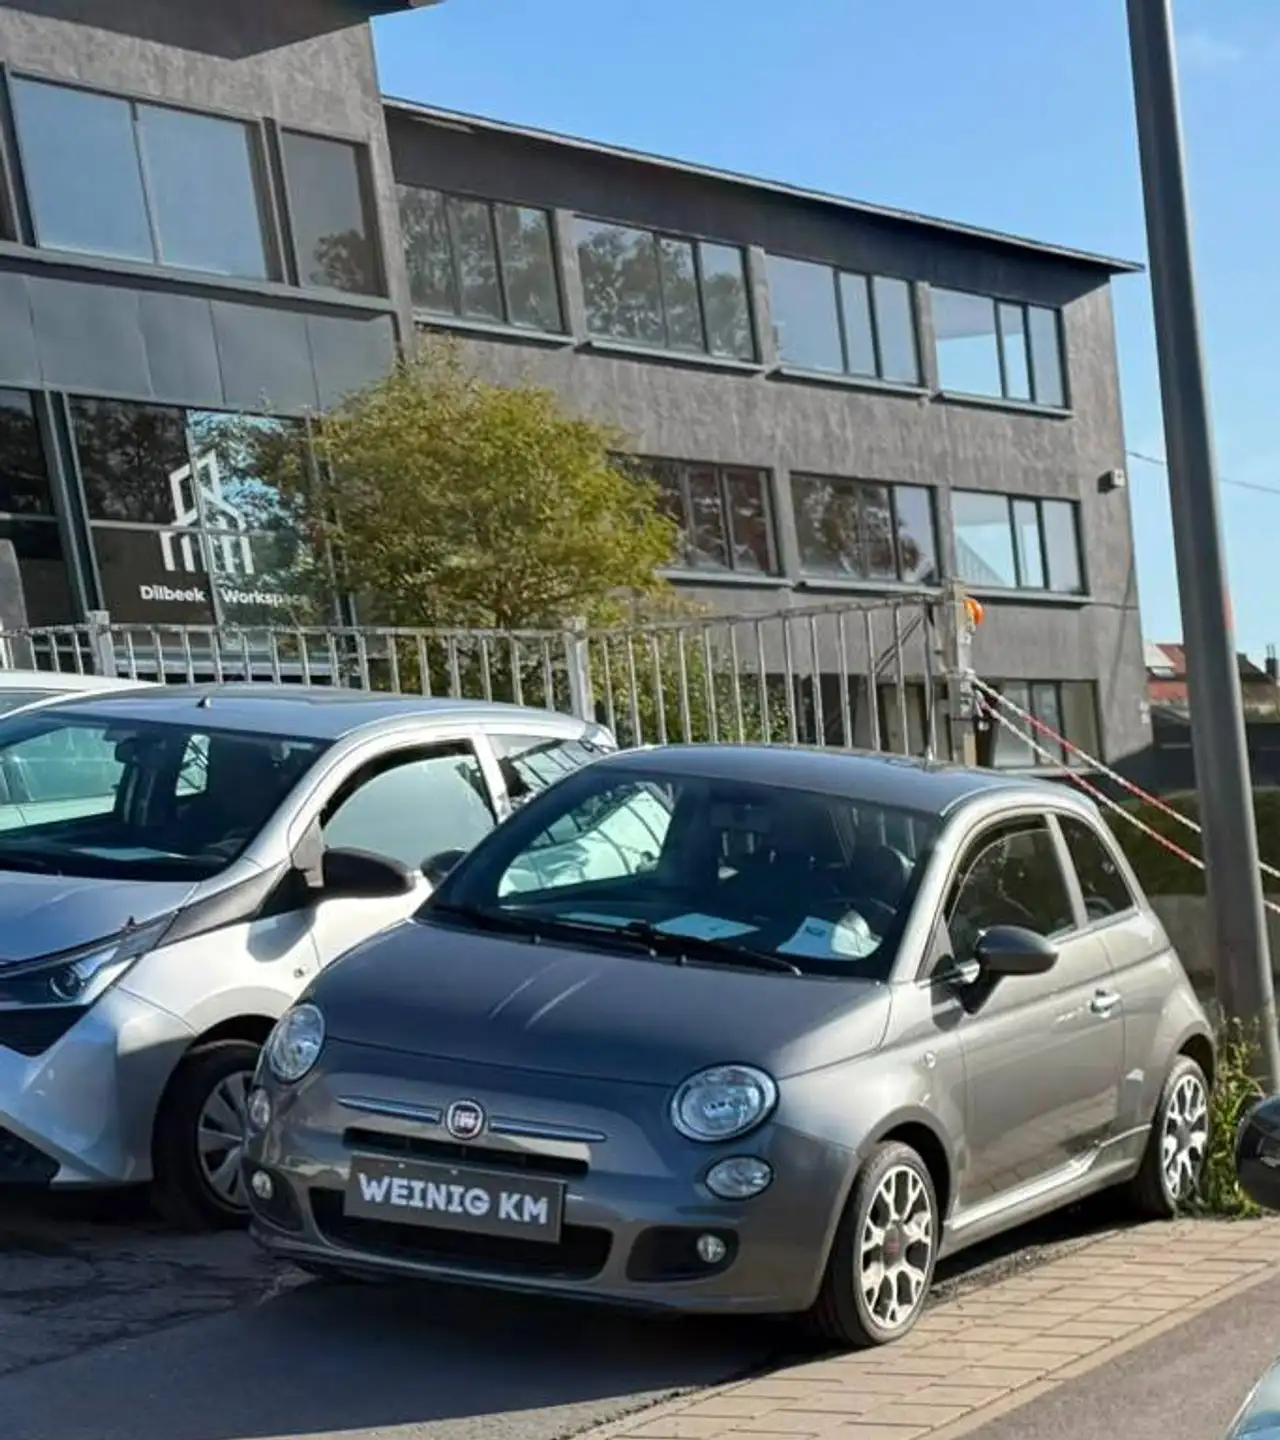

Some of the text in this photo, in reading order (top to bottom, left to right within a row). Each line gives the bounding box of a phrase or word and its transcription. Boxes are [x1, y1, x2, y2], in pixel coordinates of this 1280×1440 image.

[139, 585, 206, 602] Dilbeek
[357, 1172, 548, 1225] WEINIG KM
